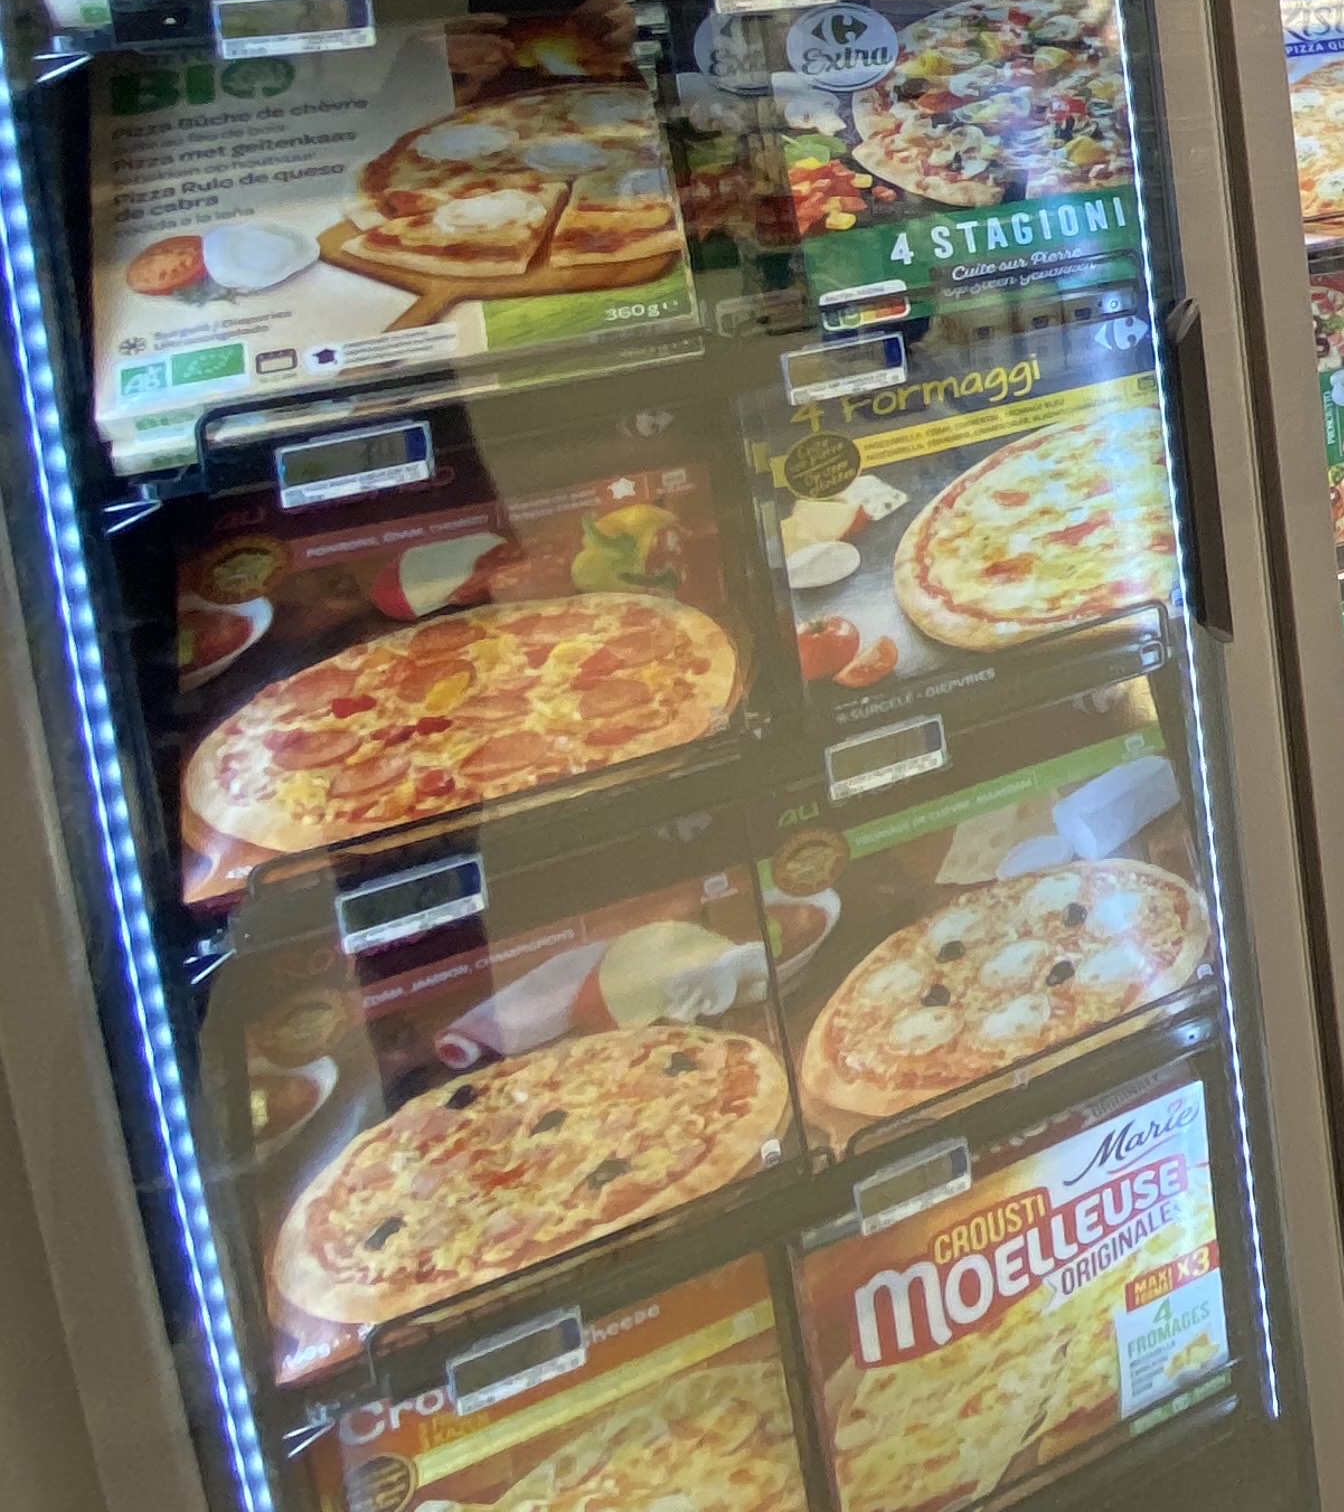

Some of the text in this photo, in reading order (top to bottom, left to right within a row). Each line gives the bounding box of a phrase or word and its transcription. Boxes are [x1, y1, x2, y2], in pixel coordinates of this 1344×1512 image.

[801, 45, 895, 76] Extra
[1285, 42, 1324, 56] PIZZA
[110, 56, 297, 117] BIO
[230, 129, 358, 159] geitenkaas
[272, 162, 346, 184] queso
[150, 193, 219, 216] cabra
[890, 195, 1128, 266] 4 STAGIONI
[840, 351, 1043, 426] Formaggi
[1063, 1097, 1202, 1188] Marie
[933, 1191, 1047, 1266] CROUSTI
[1060, 1200, 1174, 1297] ORIGINALE
[852, 1155, 1188, 1365] MOELLEUSE
[1126, 1300, 1212, 1360] FROMAGES
[1153, 1296, 1174, 1324] 4
